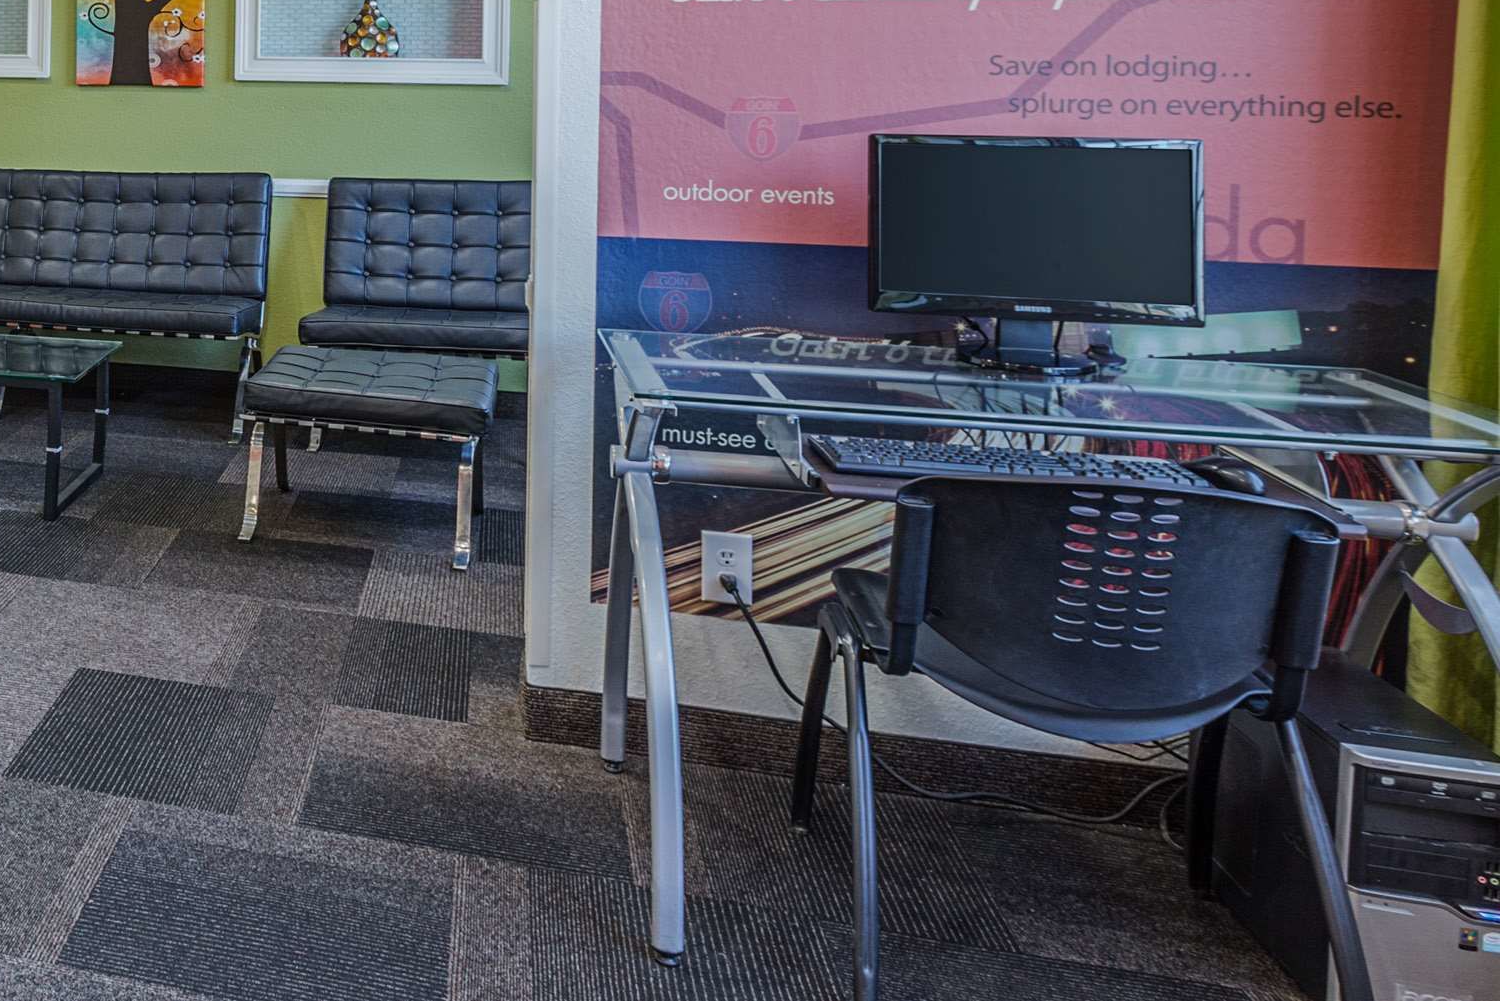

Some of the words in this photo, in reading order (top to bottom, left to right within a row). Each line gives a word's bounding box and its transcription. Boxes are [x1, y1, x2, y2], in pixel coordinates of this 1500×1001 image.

[989, 54, 1053, 77] Save
[1060, 60, 1097, 77] on
[1008, 92, 1113, 119] splurge
[1120, 97, 1157, 115] on
[1166, 94, 1326, 123] everything
[1335, 94, 1403, 119] else.
[746, 114, 778, 158] 6
[663, 180, 753, 202] outdoor
[760, 187, 835, 205] events
[660, 290, 689, 331] 6
[662, 425, 756, 449] must-see
